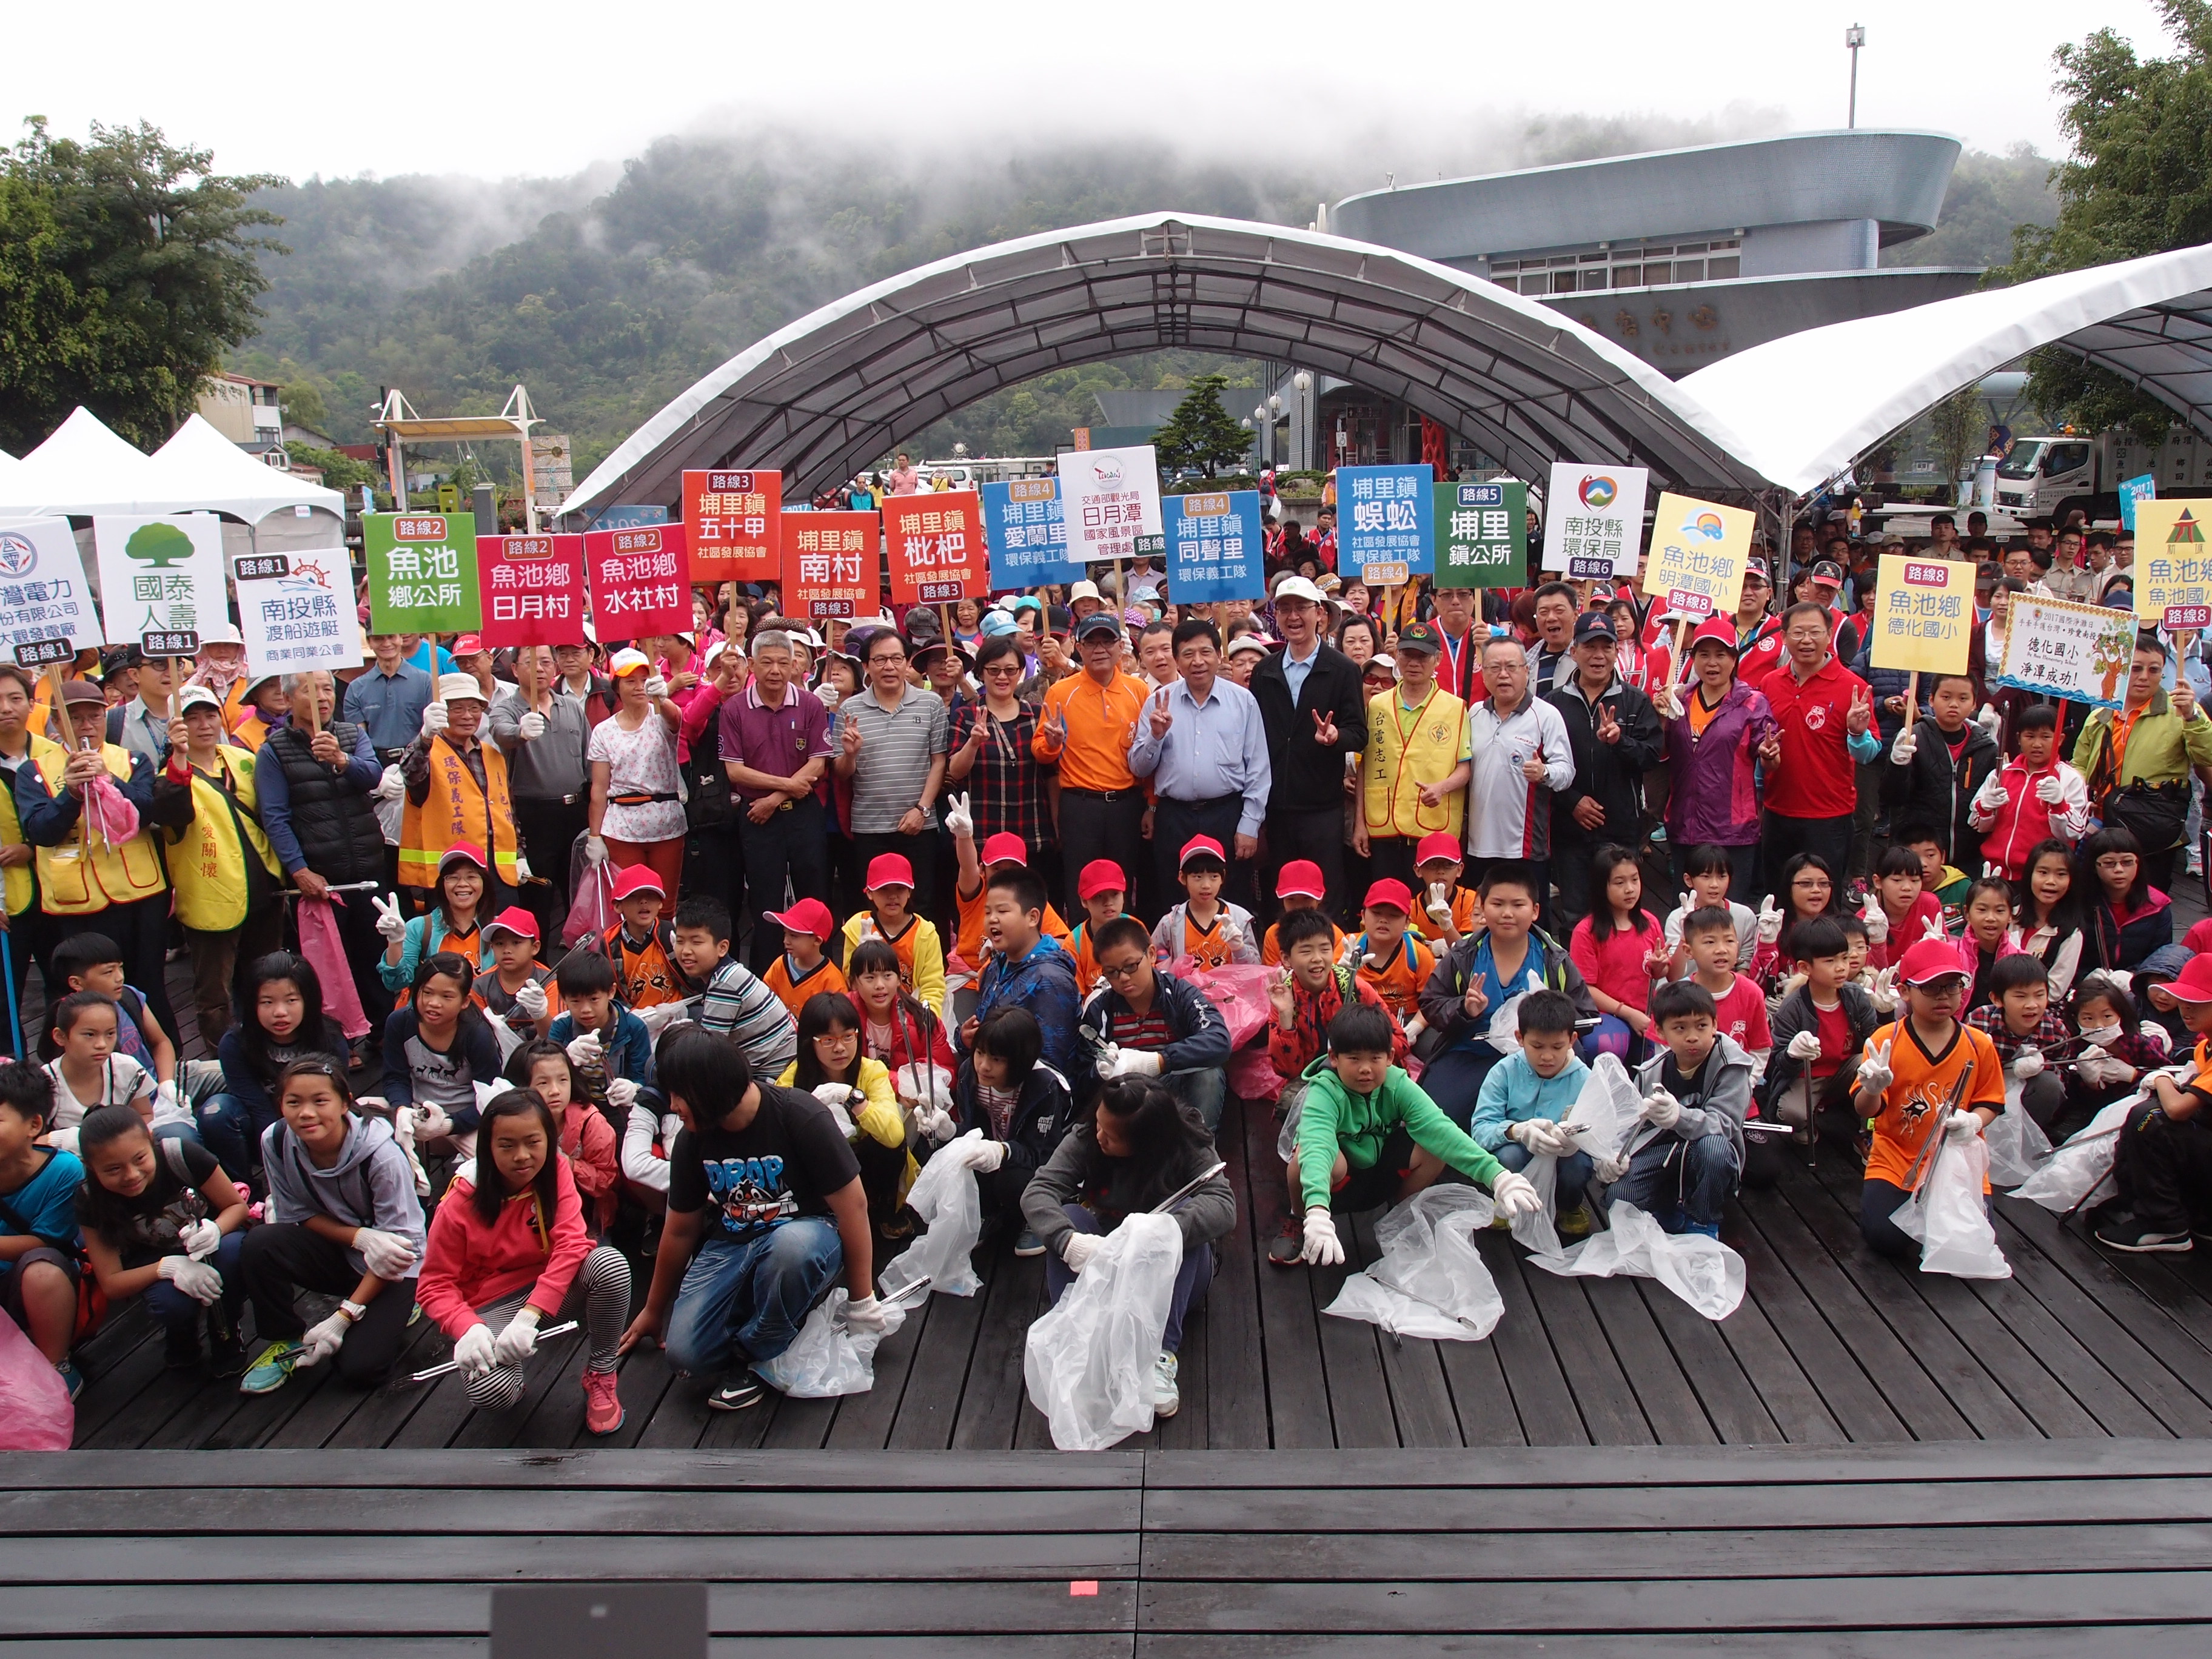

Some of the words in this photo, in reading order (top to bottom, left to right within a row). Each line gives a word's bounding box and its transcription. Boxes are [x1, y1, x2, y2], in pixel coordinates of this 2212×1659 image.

[712, 475, 749, 489] 路線3
[1014, 483, 1050, 497] 路線4
[1081, 491, 1139, 506] 交通部觀光局
[1188, 498, 1225, 512] 路線4
[1463, 488, 1498, 502] 路線5
[1083, 502, 1142, 527] 日月潭
[1354, 500, 1417, 532] 蜈蚣
[1449, 510, 1510, 541] 埔里
[400, 520, 441, 536] 路線2
[699, 517, 765, 539] 五十甲
[1004, 523, 1067, 549] 愛蘭里
[1084, 525, 1144, 541] 國家風景區
[1564, 516, 1624, 538] 南投縣
[508, 540, 548, 555] 路線2
[618, 533, 657, 549] 路線2
[903, 533, 967, 567] 枇杷
[1098, 540, 1133, 556] 管理處
[1178, 537, 1245, 563] 同聲里
[1352, 534, 1420, 549] 社區發展協會
[1562, 537, 1621, 560] 環保局
[386, 546, 459, 580] 魚池
[697, 546, 767, 559] 社區發展協會
[1352, 548, 1421, 565] 環保義工隊
[1661, 545, 1735, 580] 魚池鄉
[240, 558, 285, 576] 路線1
[491, 563, 571, 589] 魚池鄉
[600, 552, 678, 584] 魚池鄉
[799, 552, 863, 583] 南村
[903, 568, 972, 585] 社區發展協會
[1178, 565, 1247, 583] 環保義工隊
[1368, 566, 1404, 580] 路線4
[1573, 559, 1609, 575] 路線6
[1908, 565, 1945, 583] 路線8
[133, 574, 195, 601] 國泰
[797, 588, 866, 600] 社區發展協會
[923, 583, 959, 598] 路線3
[1658, 569, 1729, 598] 明潭國小
[387, 583, 462, 608] 鄉公所
[603, 583, 679, 614] 水社村
[1672, 592, 1709, 611] 路線8
[1888, 589, 1962, 619] 魚池鄉
[138, 603, 198, 631] 人壽
[261, 594, 337, 622] 南投縣
[493, 594, 571, 621] 日月村
[814, 602, 850, 615] 路線3
[2168, 609, 2207, 624] 路線8
[266, 620, 340, 642] 渡船遊艇
[1888, 617, 1958, 640] 德化國小
[19, 642, 69, 663] 路線1
[147, 634, 195, 650] 路線1
[266, 643, 344, 662] 商業同業公會
[2027, 637, 2079, 660] 德化國小
[2020, 662, 2078, 686] 淨潭成功!
[1374, 712, 1387, 780] 台電志工
[443, 756, 466, 835] 環保義工隊
[703, 1155, 784, 1193] DROP
